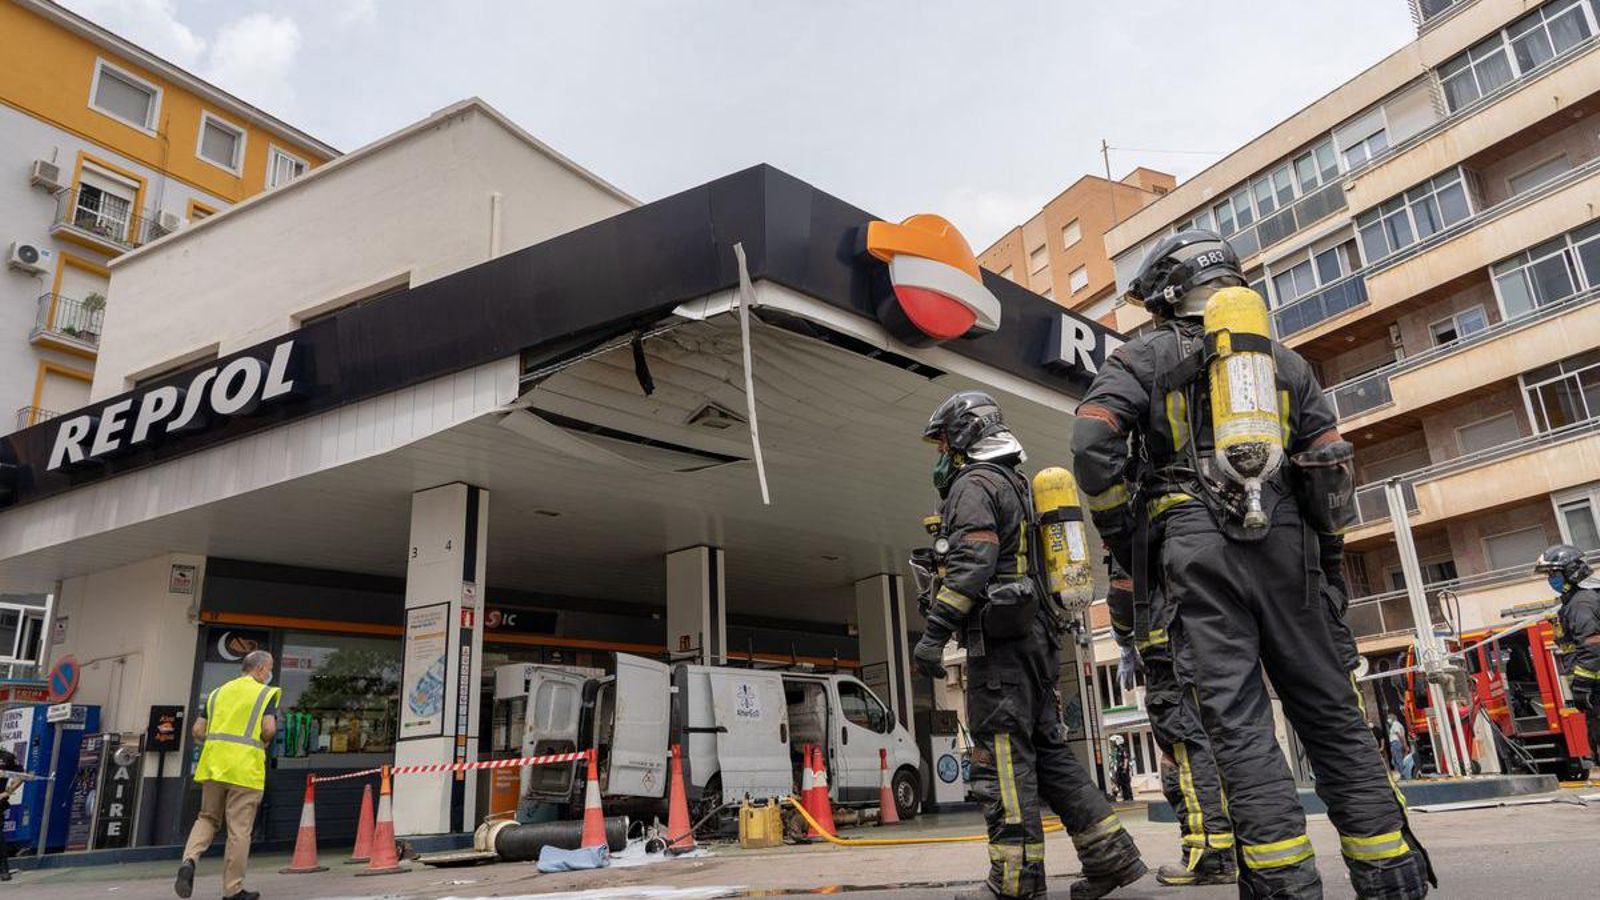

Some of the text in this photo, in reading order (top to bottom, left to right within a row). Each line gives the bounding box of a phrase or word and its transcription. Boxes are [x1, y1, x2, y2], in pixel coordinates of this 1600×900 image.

[1197, 251, 1225, 267] B83
[46, 340, 295, 471] REPSOL
[411, 546, 418, 558] 3
[445, 539, 452, 552] 4
[107, 766, 130, 836] AIRE
